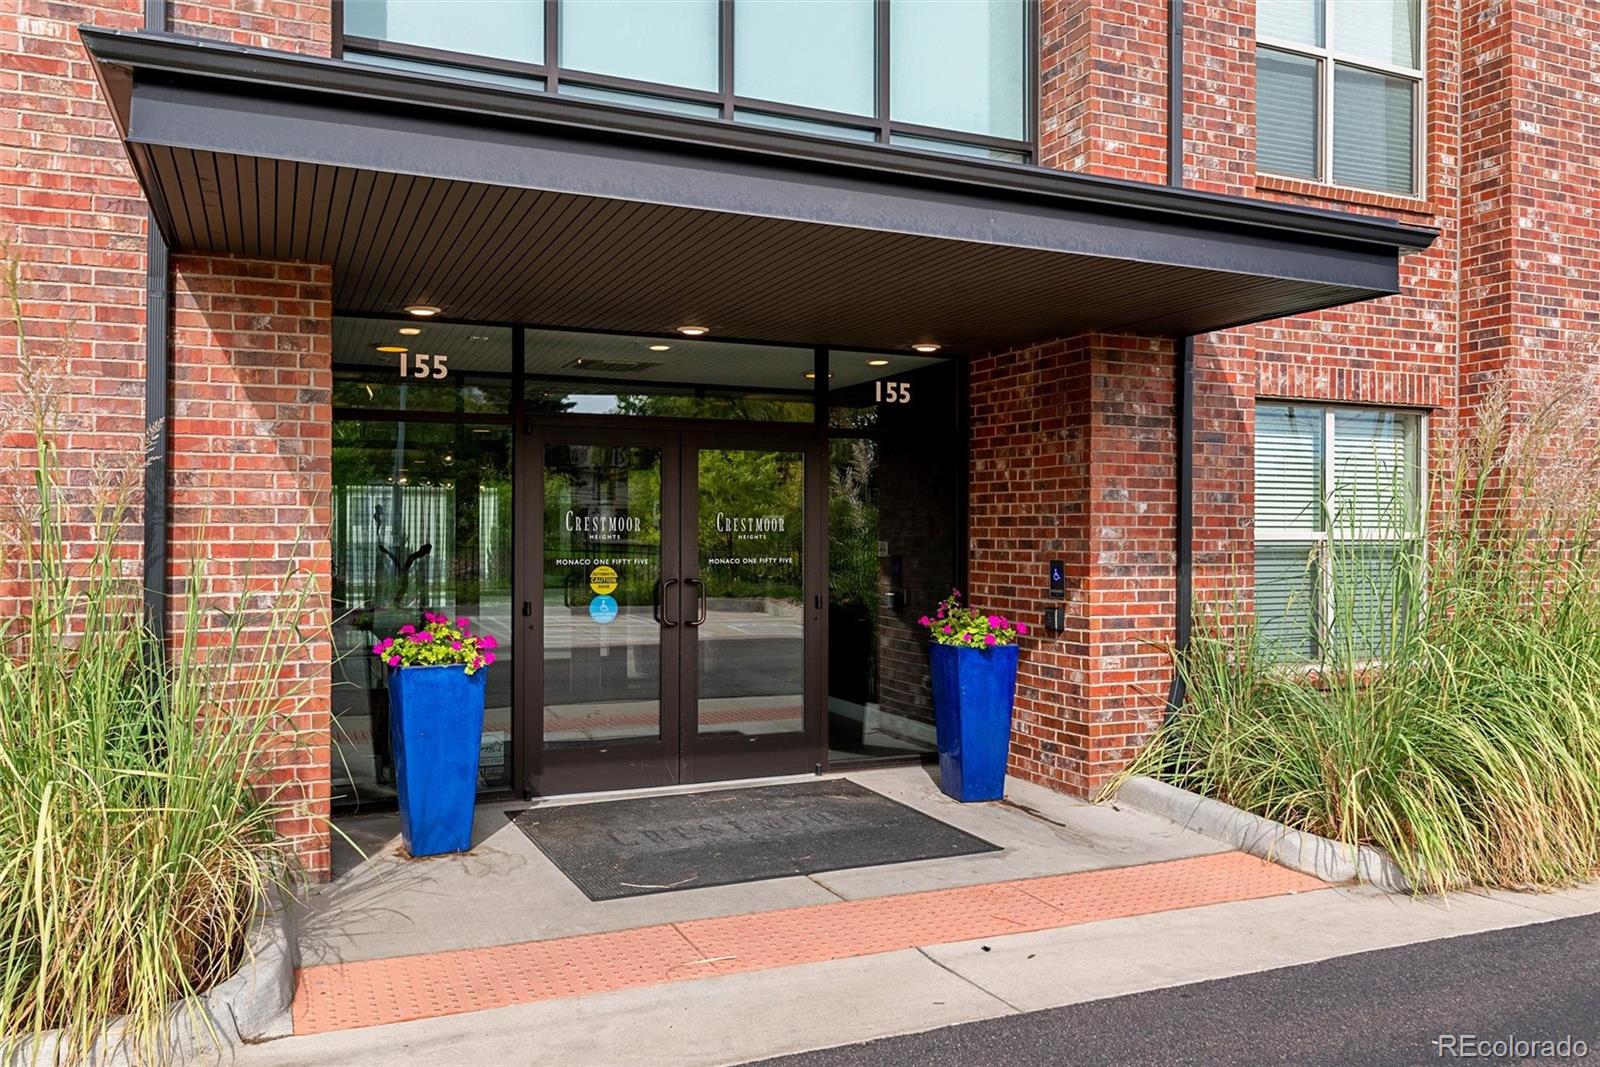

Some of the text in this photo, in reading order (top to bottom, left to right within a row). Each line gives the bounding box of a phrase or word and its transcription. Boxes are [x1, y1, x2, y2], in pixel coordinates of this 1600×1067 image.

[400, 353, 448, 379] 155
[875, 381, 911, 403] 155
[565, 510, 641, 532] CRESTMOOR
[716, 512, 785, 532] CRESTMOOR
[593, 558, 609, 566] ONE
